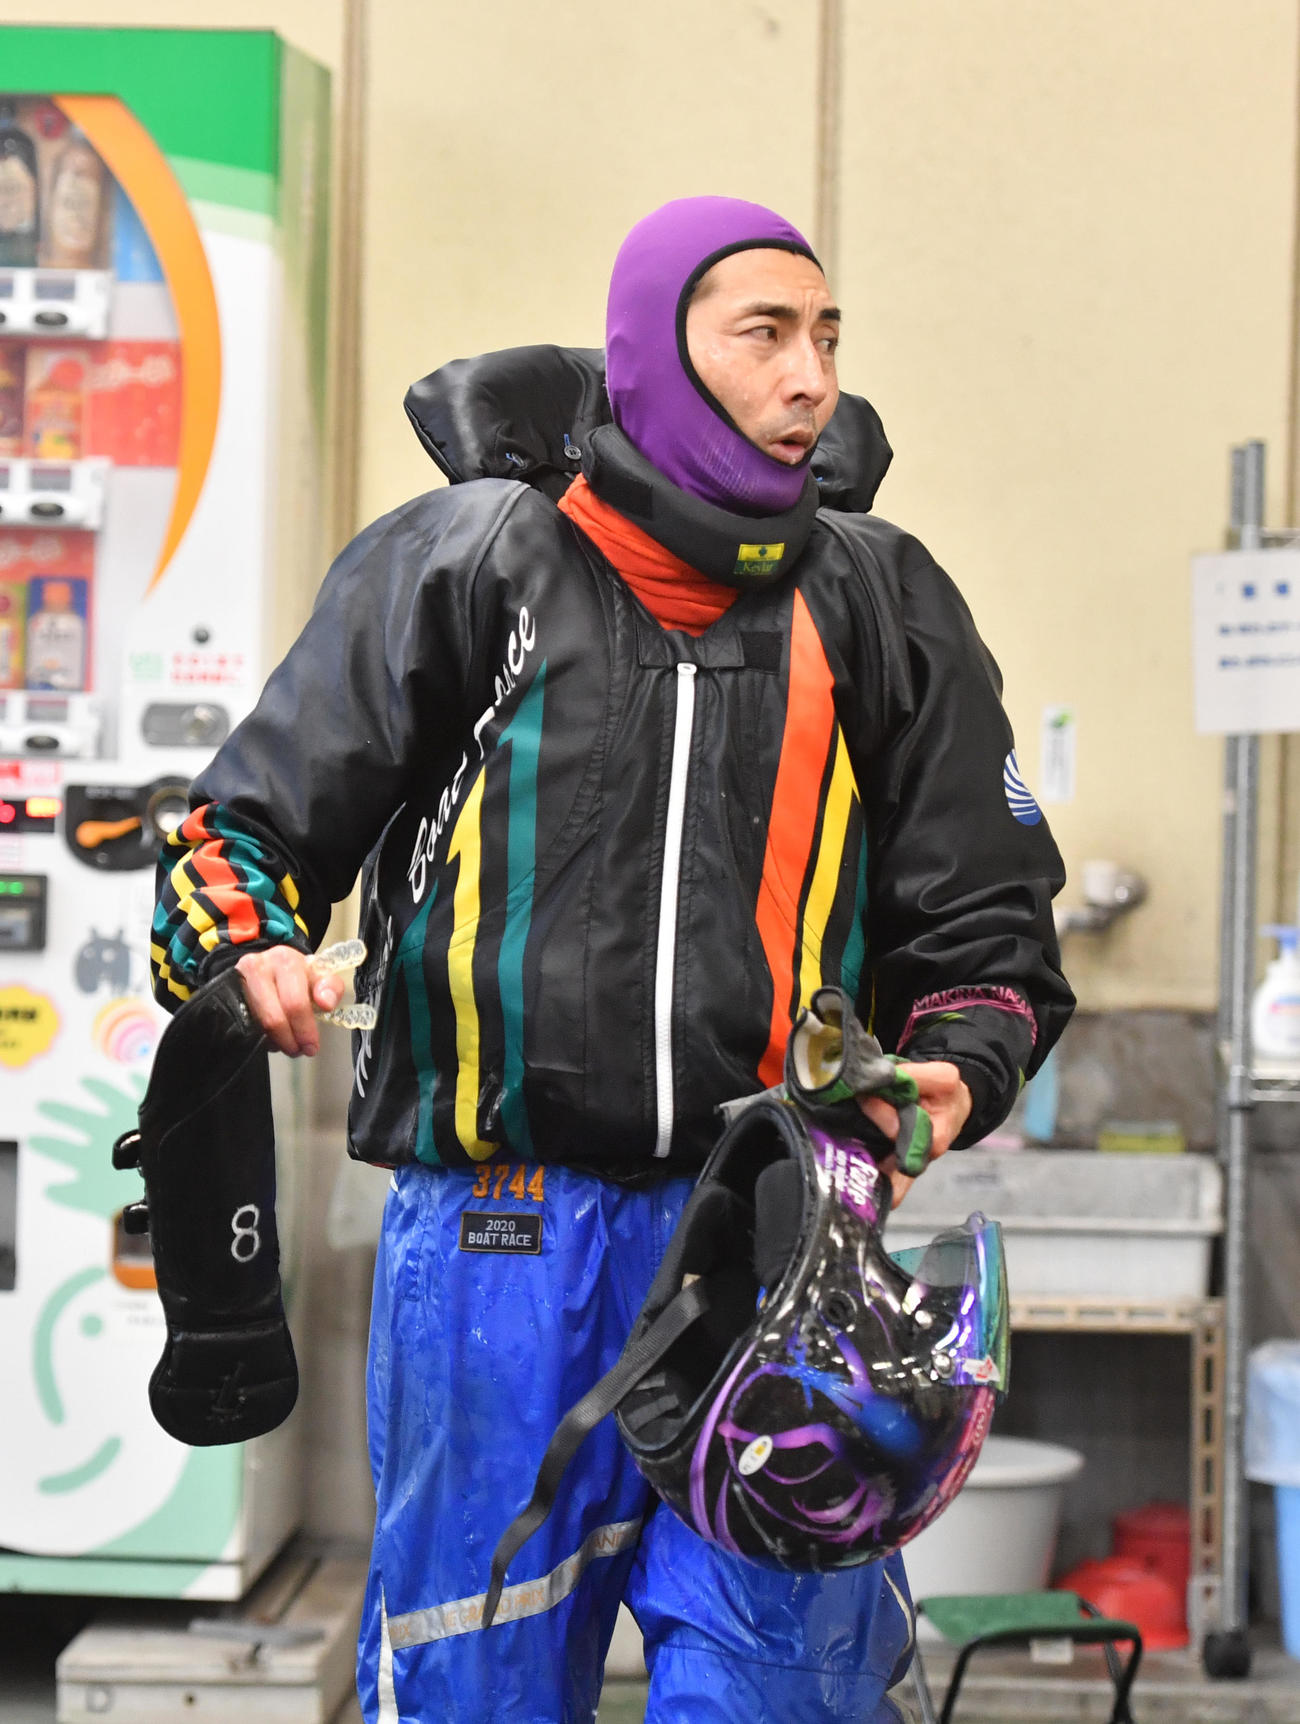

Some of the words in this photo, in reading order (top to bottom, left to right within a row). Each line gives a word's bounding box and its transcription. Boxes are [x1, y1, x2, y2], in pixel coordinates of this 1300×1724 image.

[472, 1164, 545, 1202] 3744
[231, 1204, 260, 1263] 8
[468, 1232, 499, 1245] BOAT
[501, 1234, 532, 1246] RACE
[485, 1220, 516, 1232] 2020
